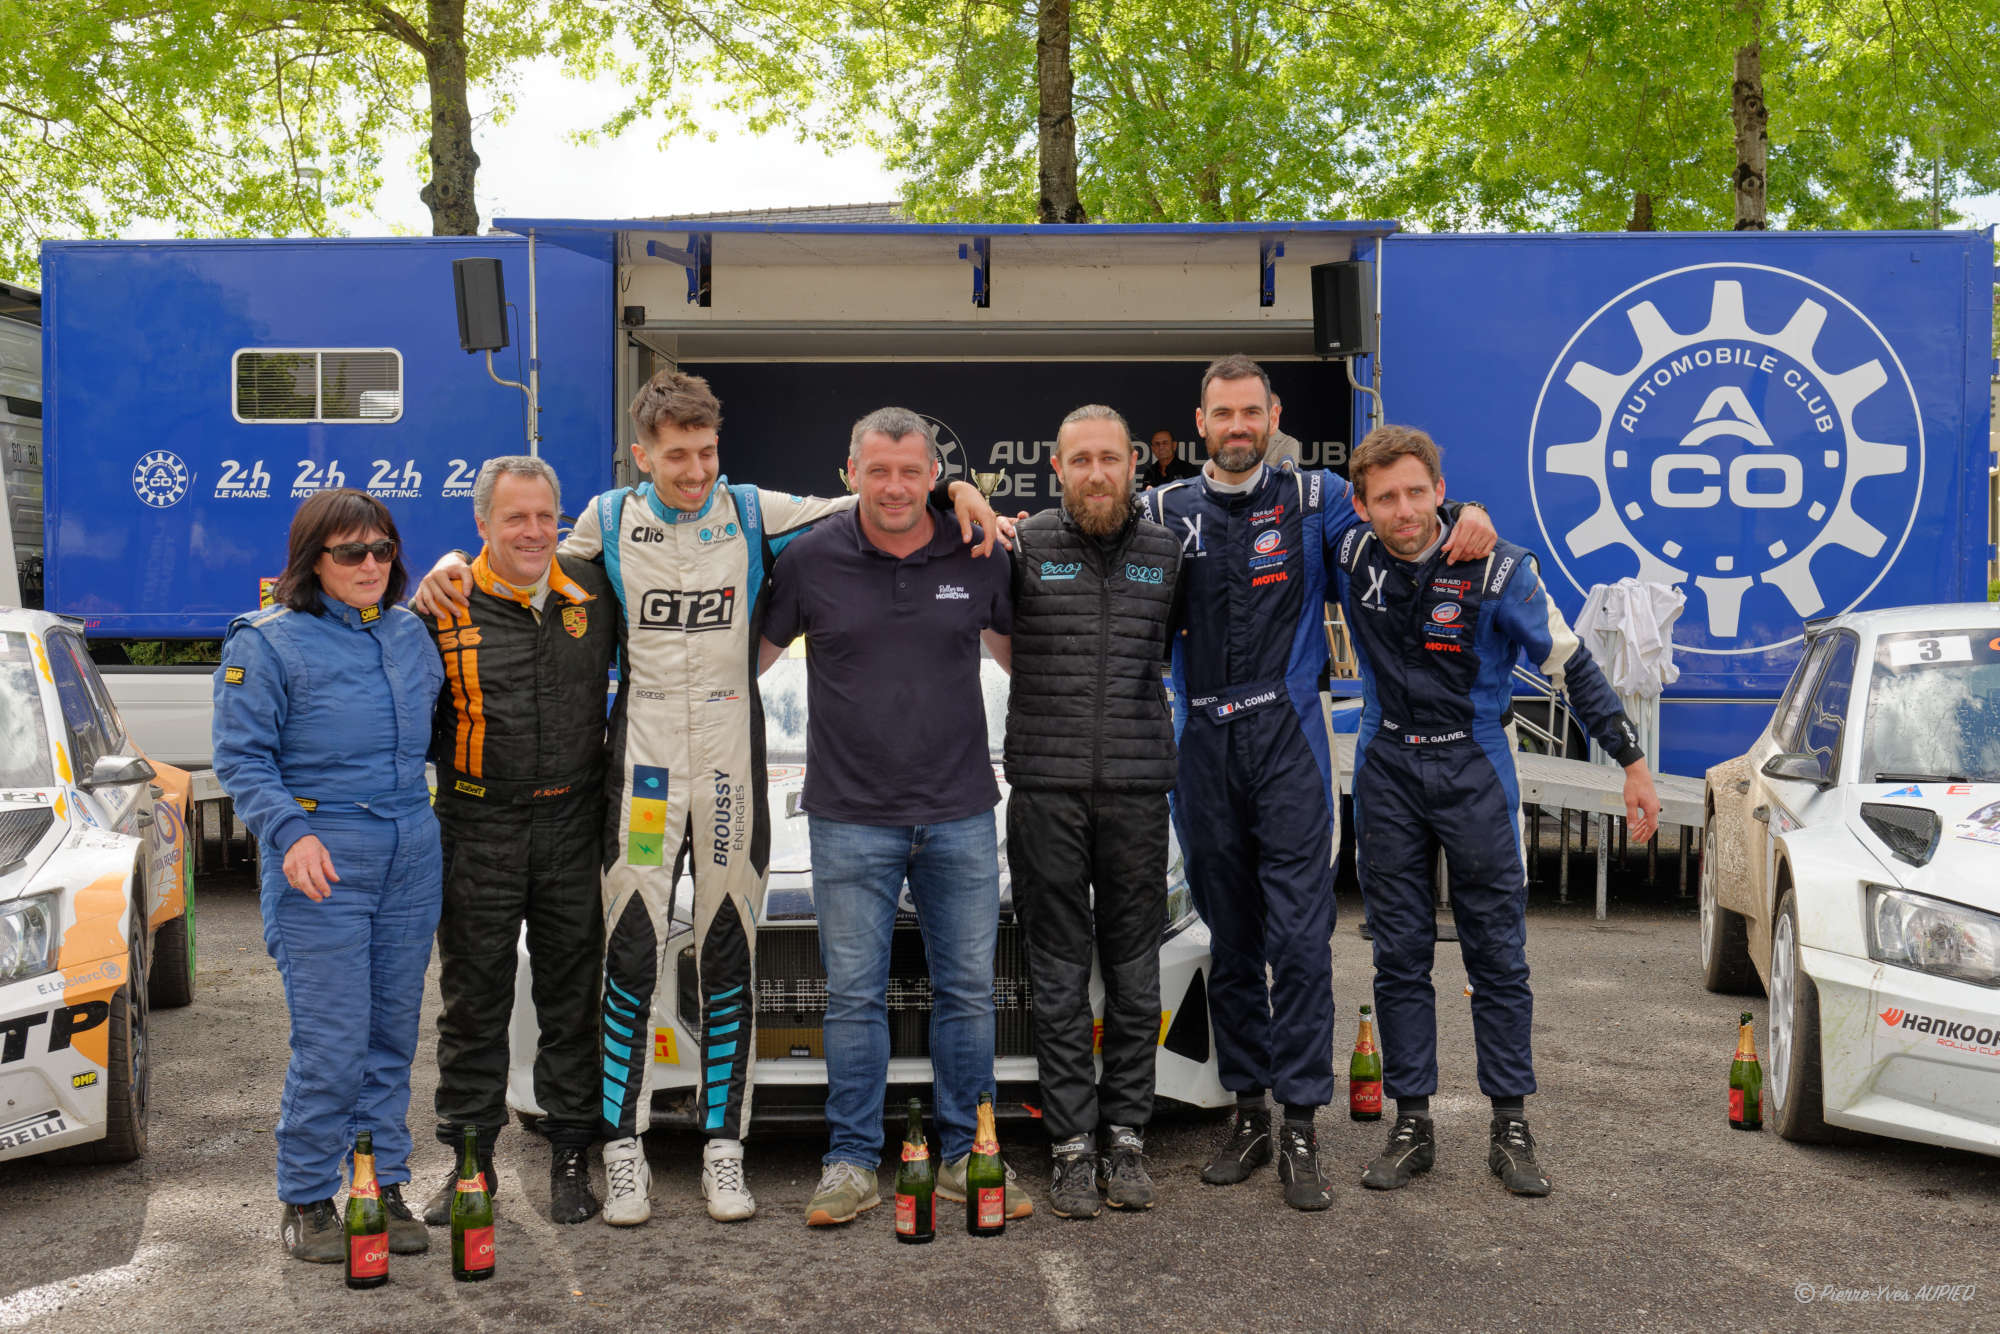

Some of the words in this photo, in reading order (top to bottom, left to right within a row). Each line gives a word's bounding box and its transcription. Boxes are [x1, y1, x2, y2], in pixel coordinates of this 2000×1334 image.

[1621, 347, 1778, 433] AUTOMOBILE
[1783, 370, 1833, 433] CLUB
[28, 445, 37, 464] 80
[214, 490, 230, 498] LE
[631, 526, 664, 543] Clio
[1252, 571, 1288, 588] MOTUL
[1491, 556, 1514, 594] sparco
[361, 609, 381, 620] OMP
[642, 588, 734, 626] GT2i
[1425, 642, 1462, 653] MOTUL
[1918, 640, 1942, 661] 3
[1235, 702, 1245, 710] A.
[1245, 691, 1277, 707] CONAN
[1430, 731, 1467, 744] GALIVEL
[713, 769, 732, 868] BROUSSY
[732, 784, 745, 852] ÉNERGIES
[37, 971, 102, 995] E.Leclerc
[73, 1073, 96, 1087] OMP
